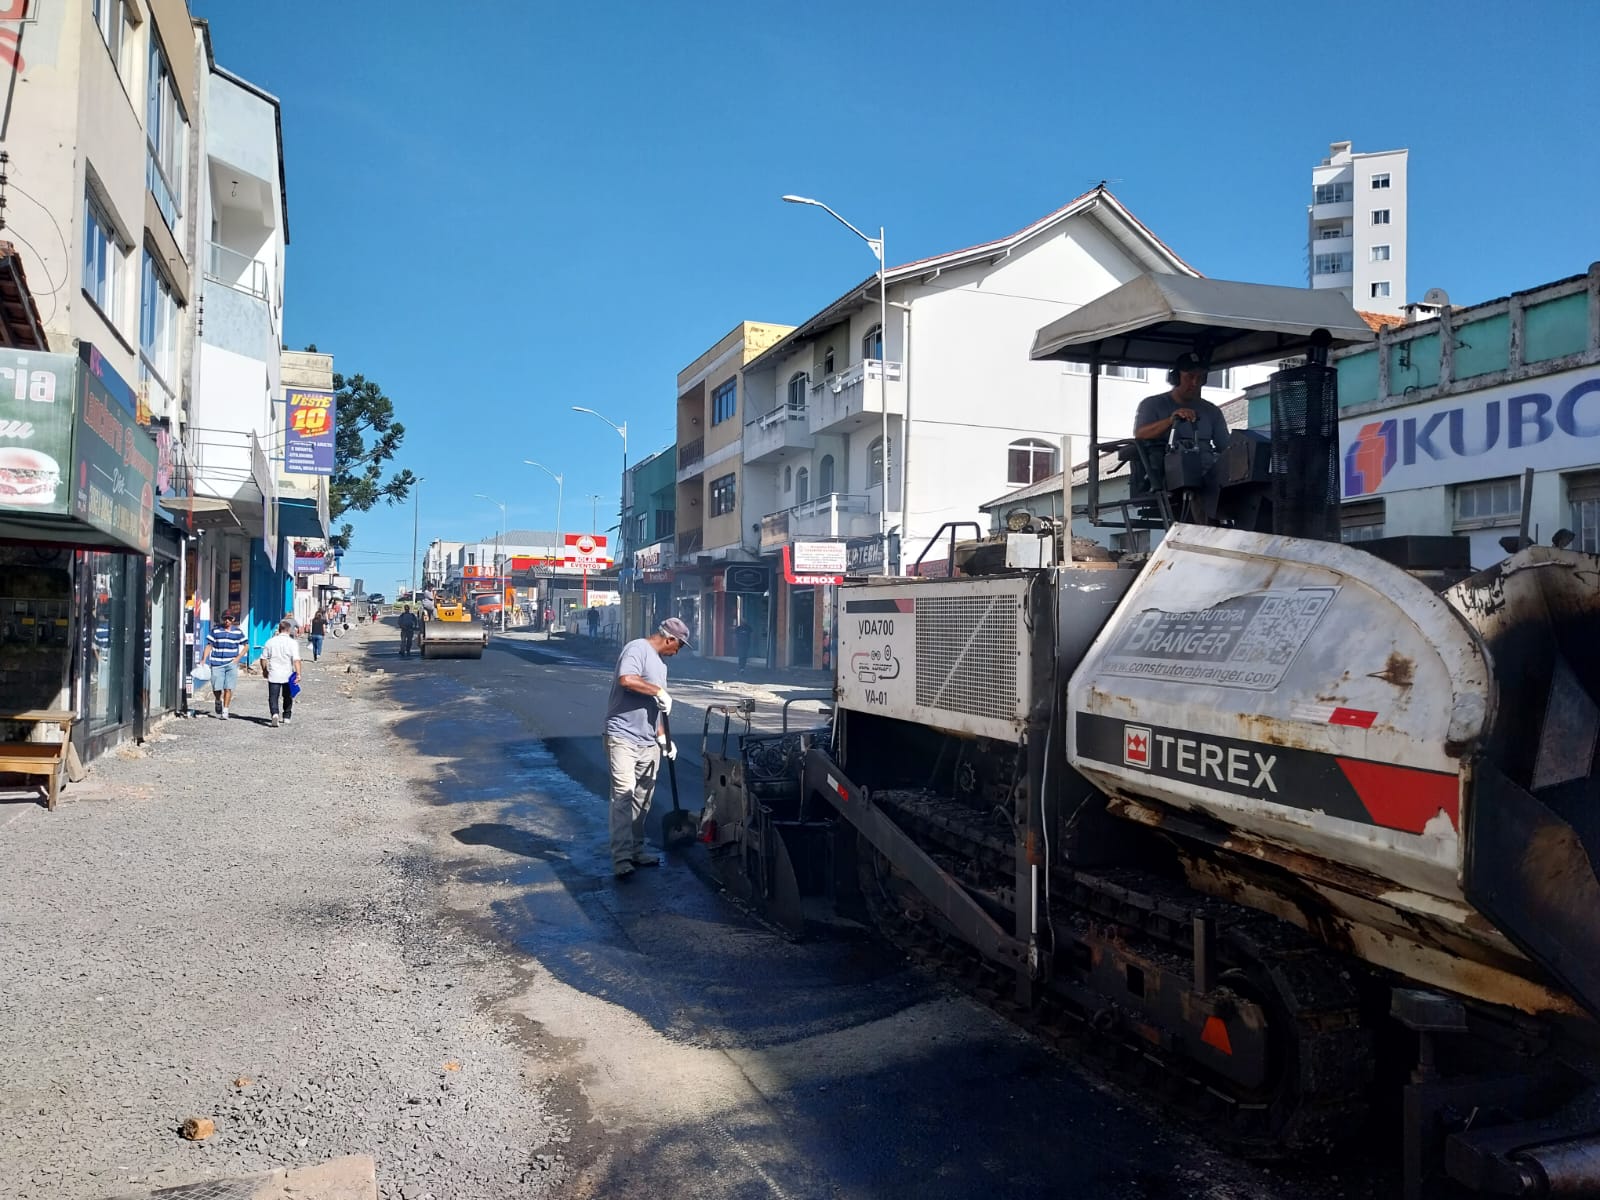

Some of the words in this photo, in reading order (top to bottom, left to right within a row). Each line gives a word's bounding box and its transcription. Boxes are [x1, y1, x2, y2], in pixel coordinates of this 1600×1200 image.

[293, 408, 327, 431] 10
[795, 576, 836, 584] XEROX
[858, 619, 894, 636] VDA700
[1122, 611, 1231, 655] BRANGER
[1103, 661, 1277, 684] www.construtorabranger.com
[865, 689, 888, 705] VA-01
[1155, 734, 1278, 793] TEREX
